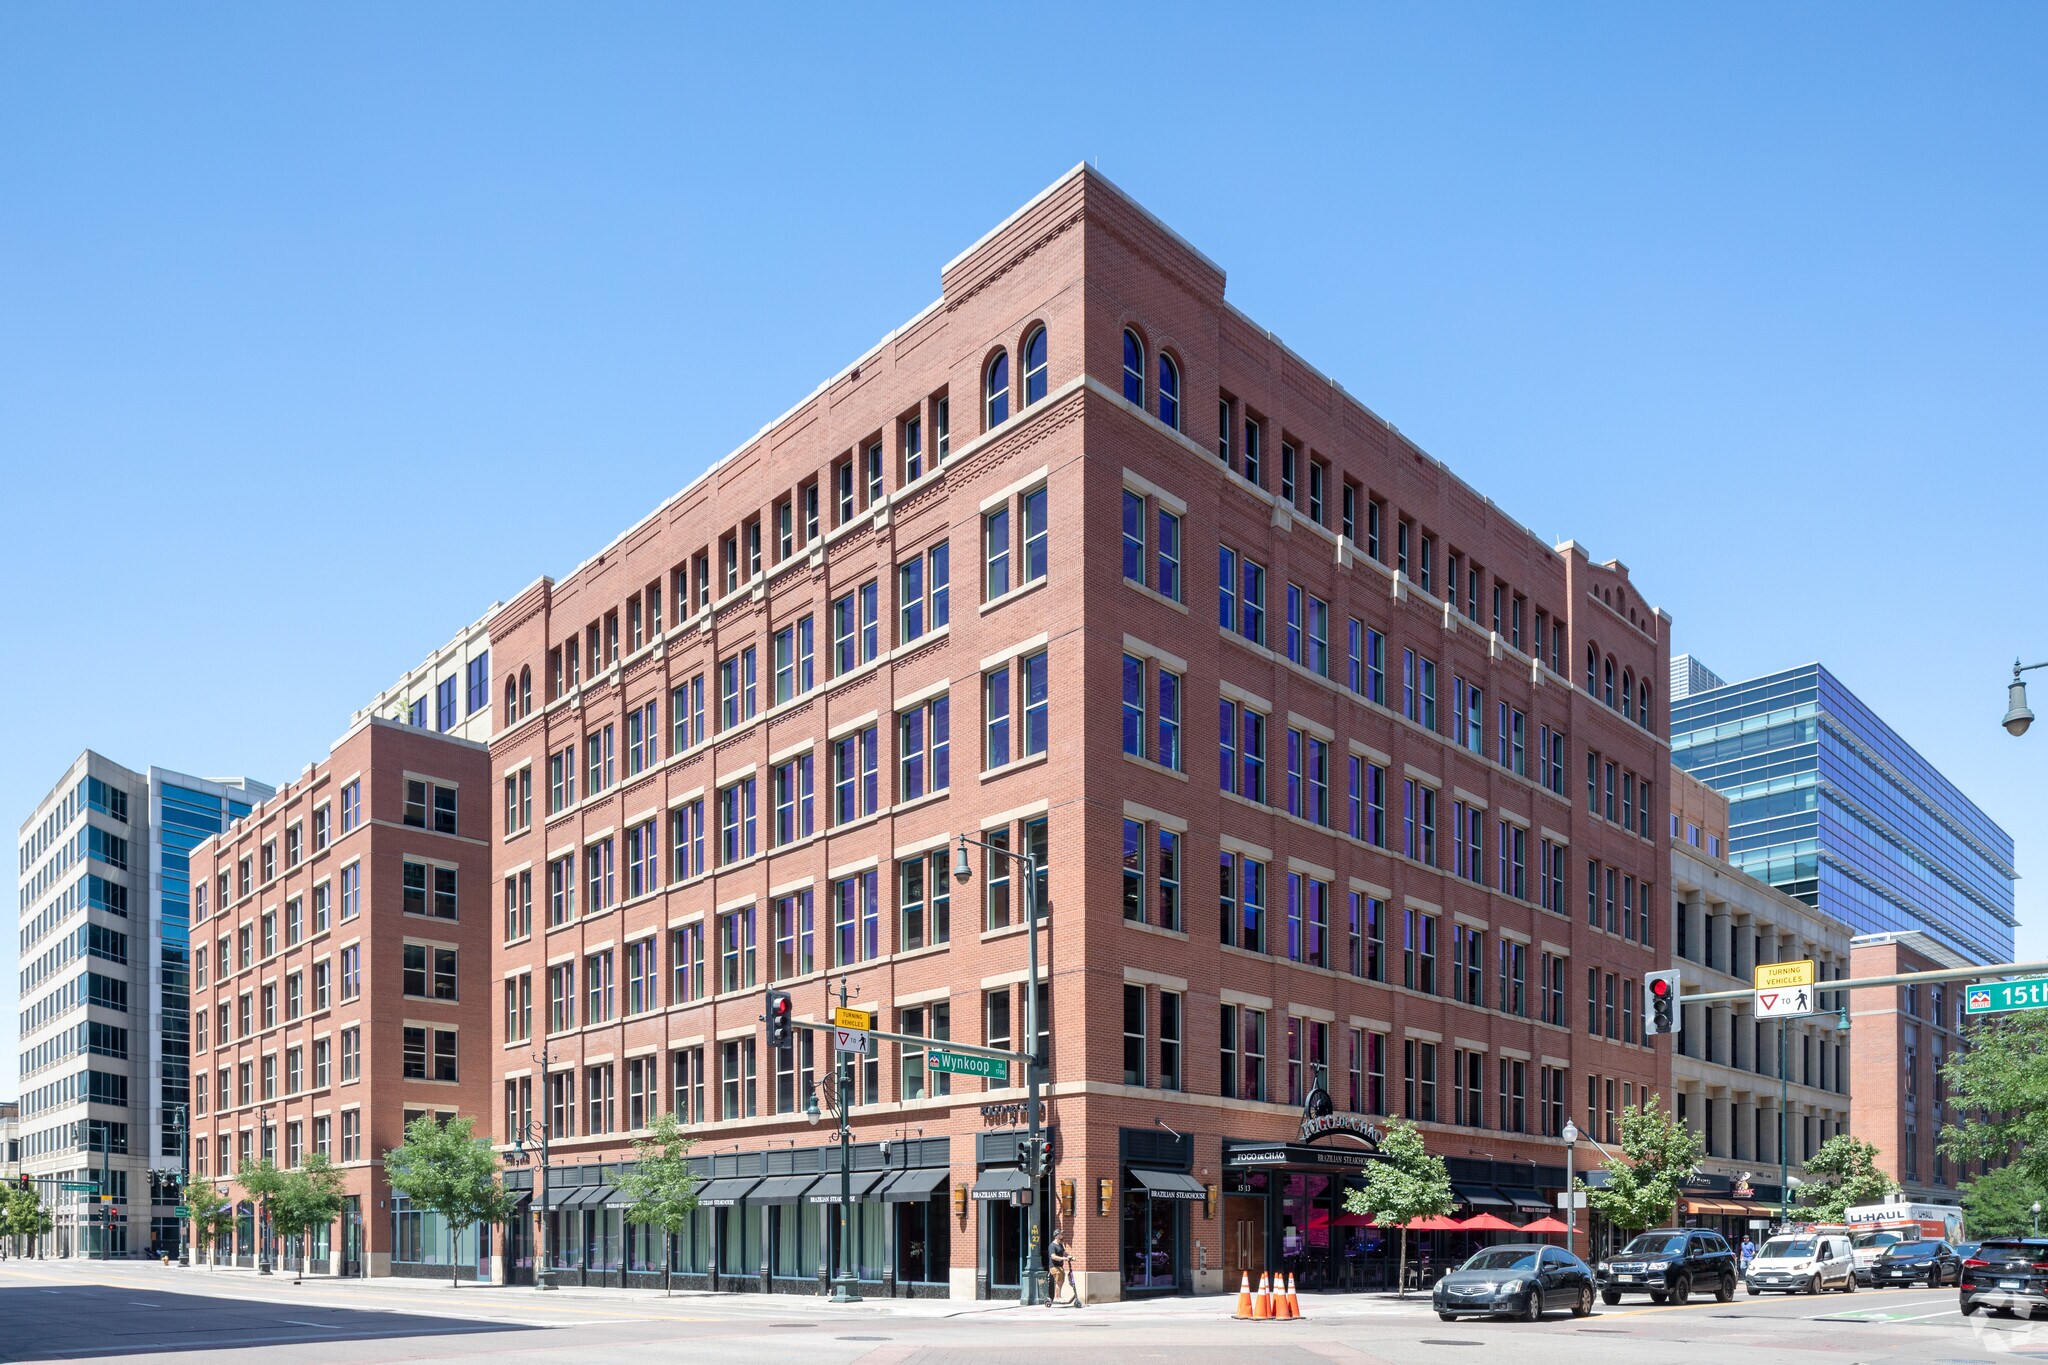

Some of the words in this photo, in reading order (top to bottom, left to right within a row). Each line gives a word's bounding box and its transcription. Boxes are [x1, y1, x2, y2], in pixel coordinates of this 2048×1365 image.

[1769, 967, 1800, 976] TURNING
[1767, 976, 1802, 985] VEHICLES
[843, 1011, 863, 1020] TURNING
[841, 1020, 864, 1028] VEHICLES
[941, 1054, 990, 1075] Wynkoop
[1300, 1114, 1336, 1139] FOGO
[1237, 1153, 1257, 1161] FOGO
[1317, 1154, 1342, 1163] BRAZILIAN
[1151, 1190, 1175, 1198] BRAZILIAN
[1176, 1191, 1206, 1199] STEAKHOUSE
[1850, 1210, 1905, 1222] U-HAUL
